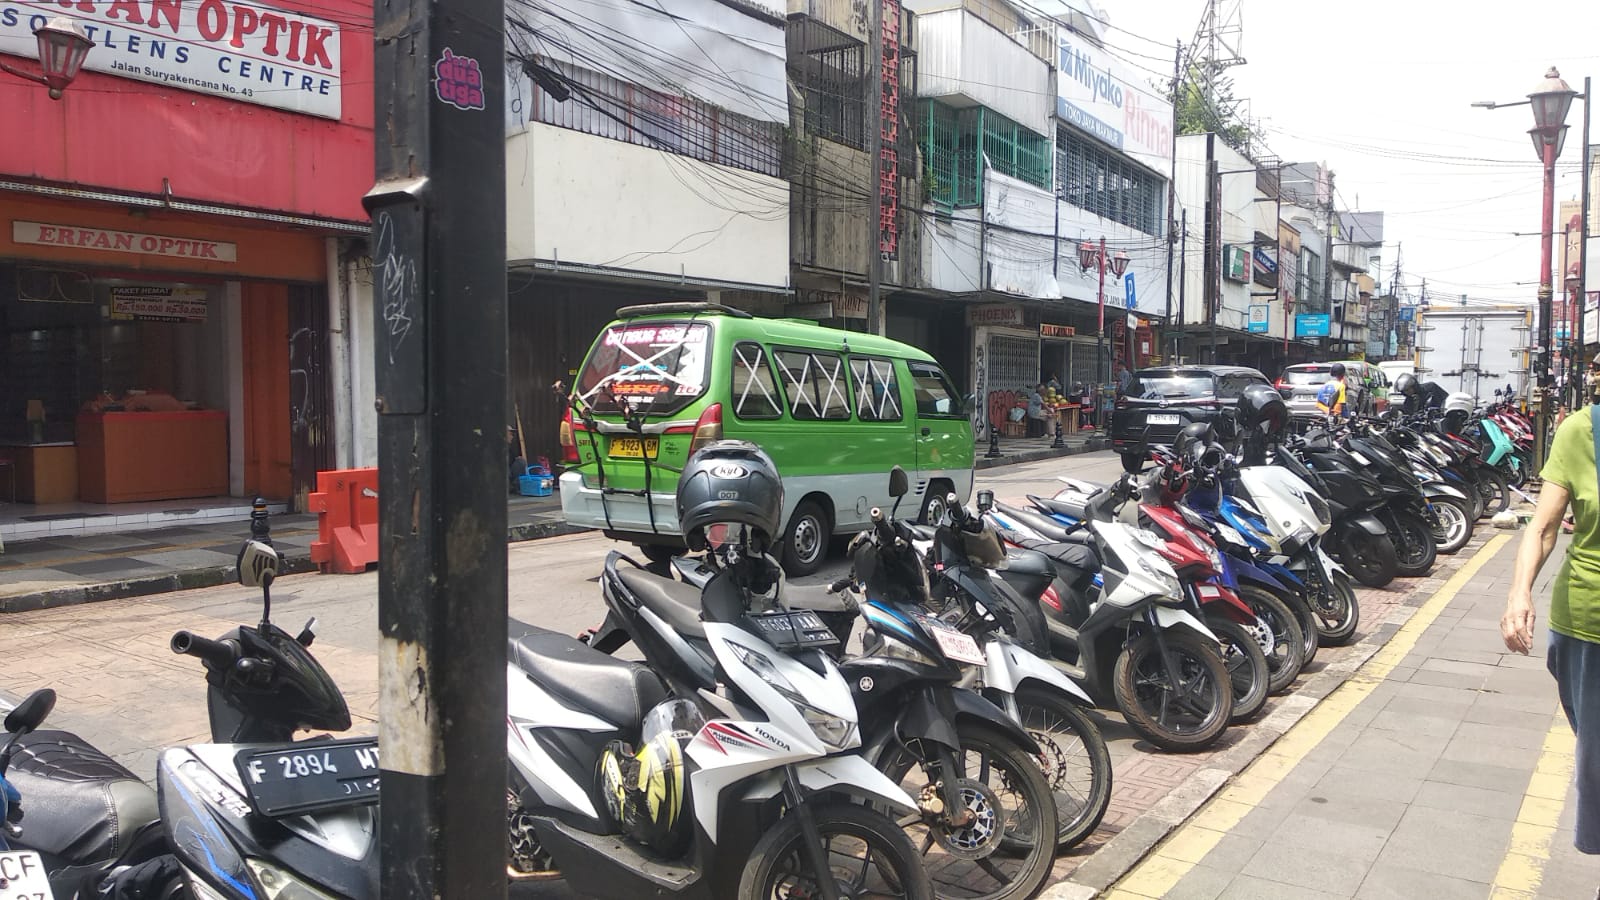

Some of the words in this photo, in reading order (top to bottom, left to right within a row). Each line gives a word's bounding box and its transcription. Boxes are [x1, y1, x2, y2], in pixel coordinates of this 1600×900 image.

[197, 0, 333, 69] OPTIK
[2, 8, 189, 63] SOTLENS
[218, 57, 330, 95] CENTRE
[111, 60, 141, 74] Jalan
[144, 66, 219, 90] Suryakencana
[222, 82, 237, 94] No.
[241, 88, 253, 97] 43
[1074, 48, 1122, 109] Miyako
[1065, 103, 1081, 123] TOKO
[1082, 113, 1095, 130] JAYA
[37, 225, 133, 251] ERFAN
[140, 236, 218, 259] OPTIK
[142, 287, 170, 295] HEMAT
[970, 307, 1017, 321] PHOENIX
[620, 439, 640, 451] 1923
[755, 726, 791, 752] HONDA
[247, 759, 267, 785] F
[278, 752, 338, 779] 2894
[0, 854, 36, 881] CF
